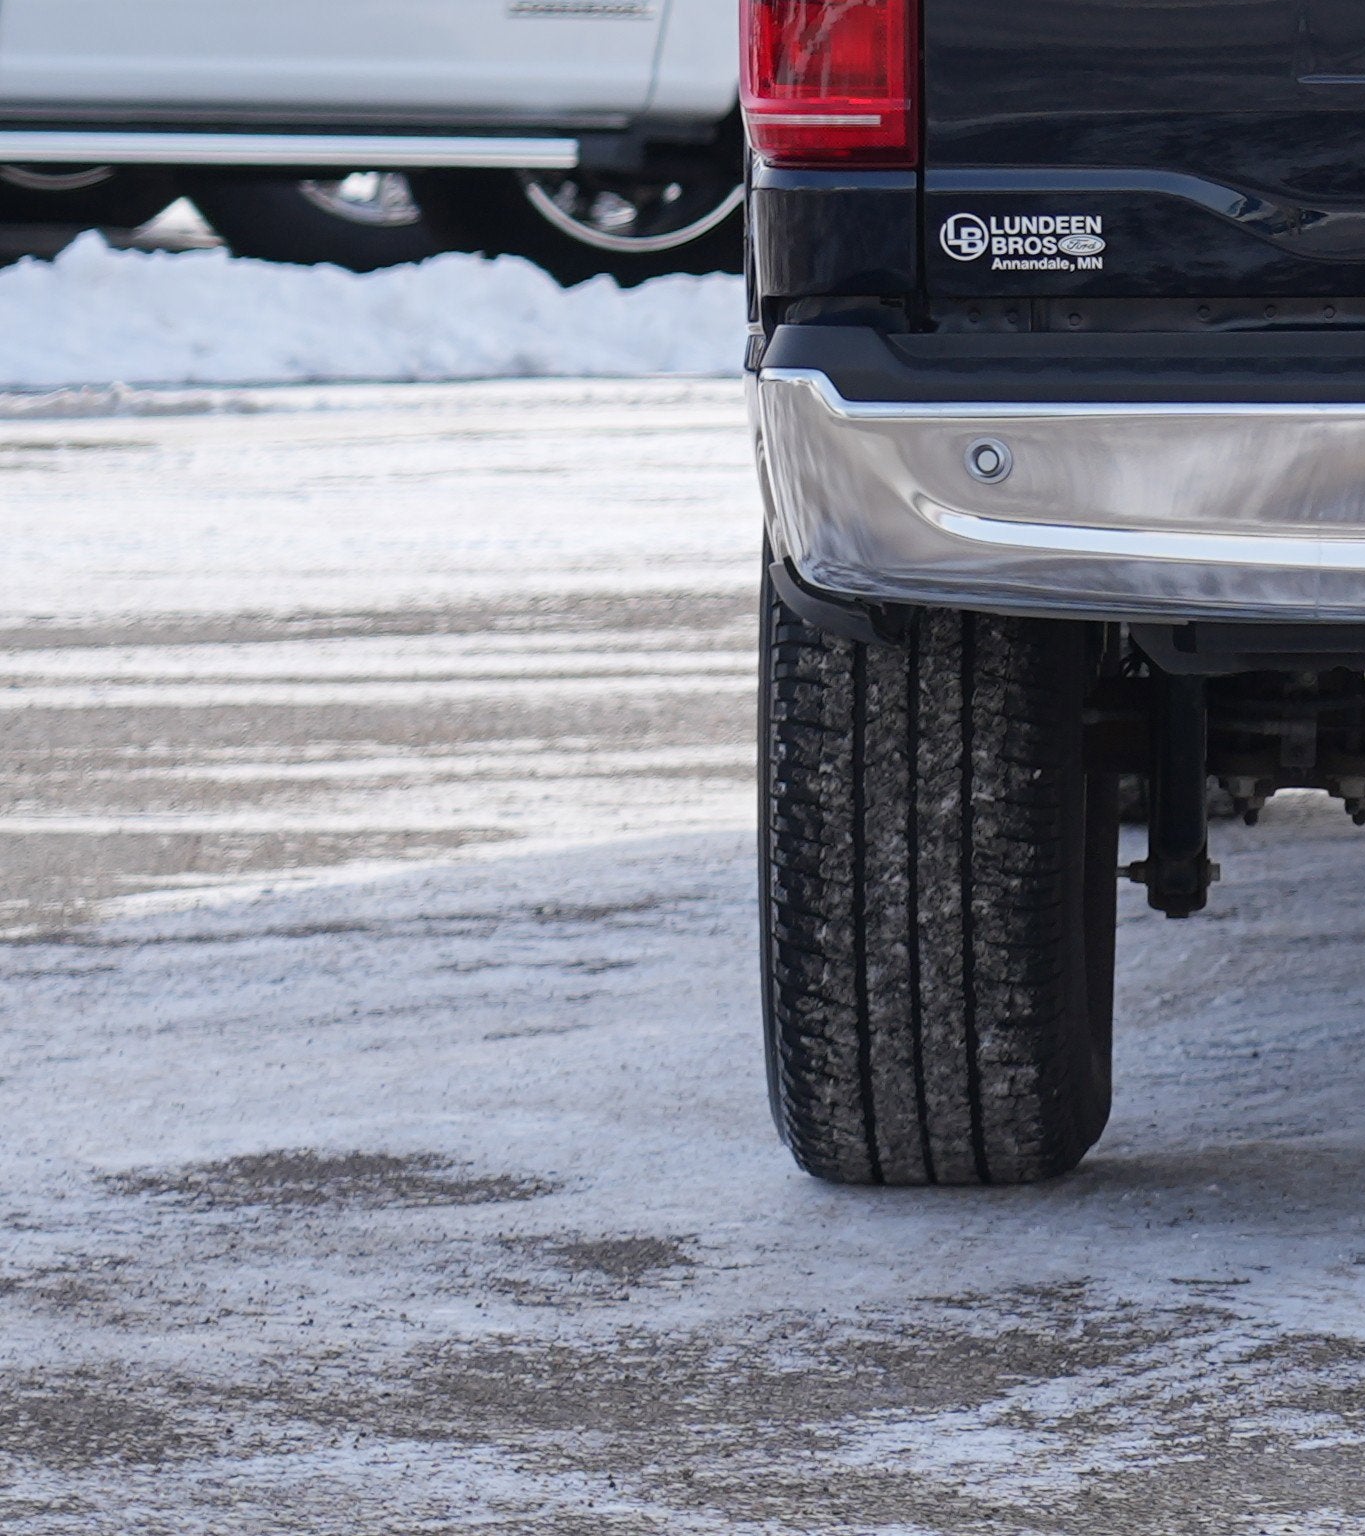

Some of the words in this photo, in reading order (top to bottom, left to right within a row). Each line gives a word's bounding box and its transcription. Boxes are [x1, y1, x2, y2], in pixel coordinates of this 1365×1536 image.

[990, 216, 1102, 235] LUNDEEN
[991, 236, 1058, 255] BROS
[991, 256, 1076, 272] Annandale,
[1077, 256, 1103, 270] MN
